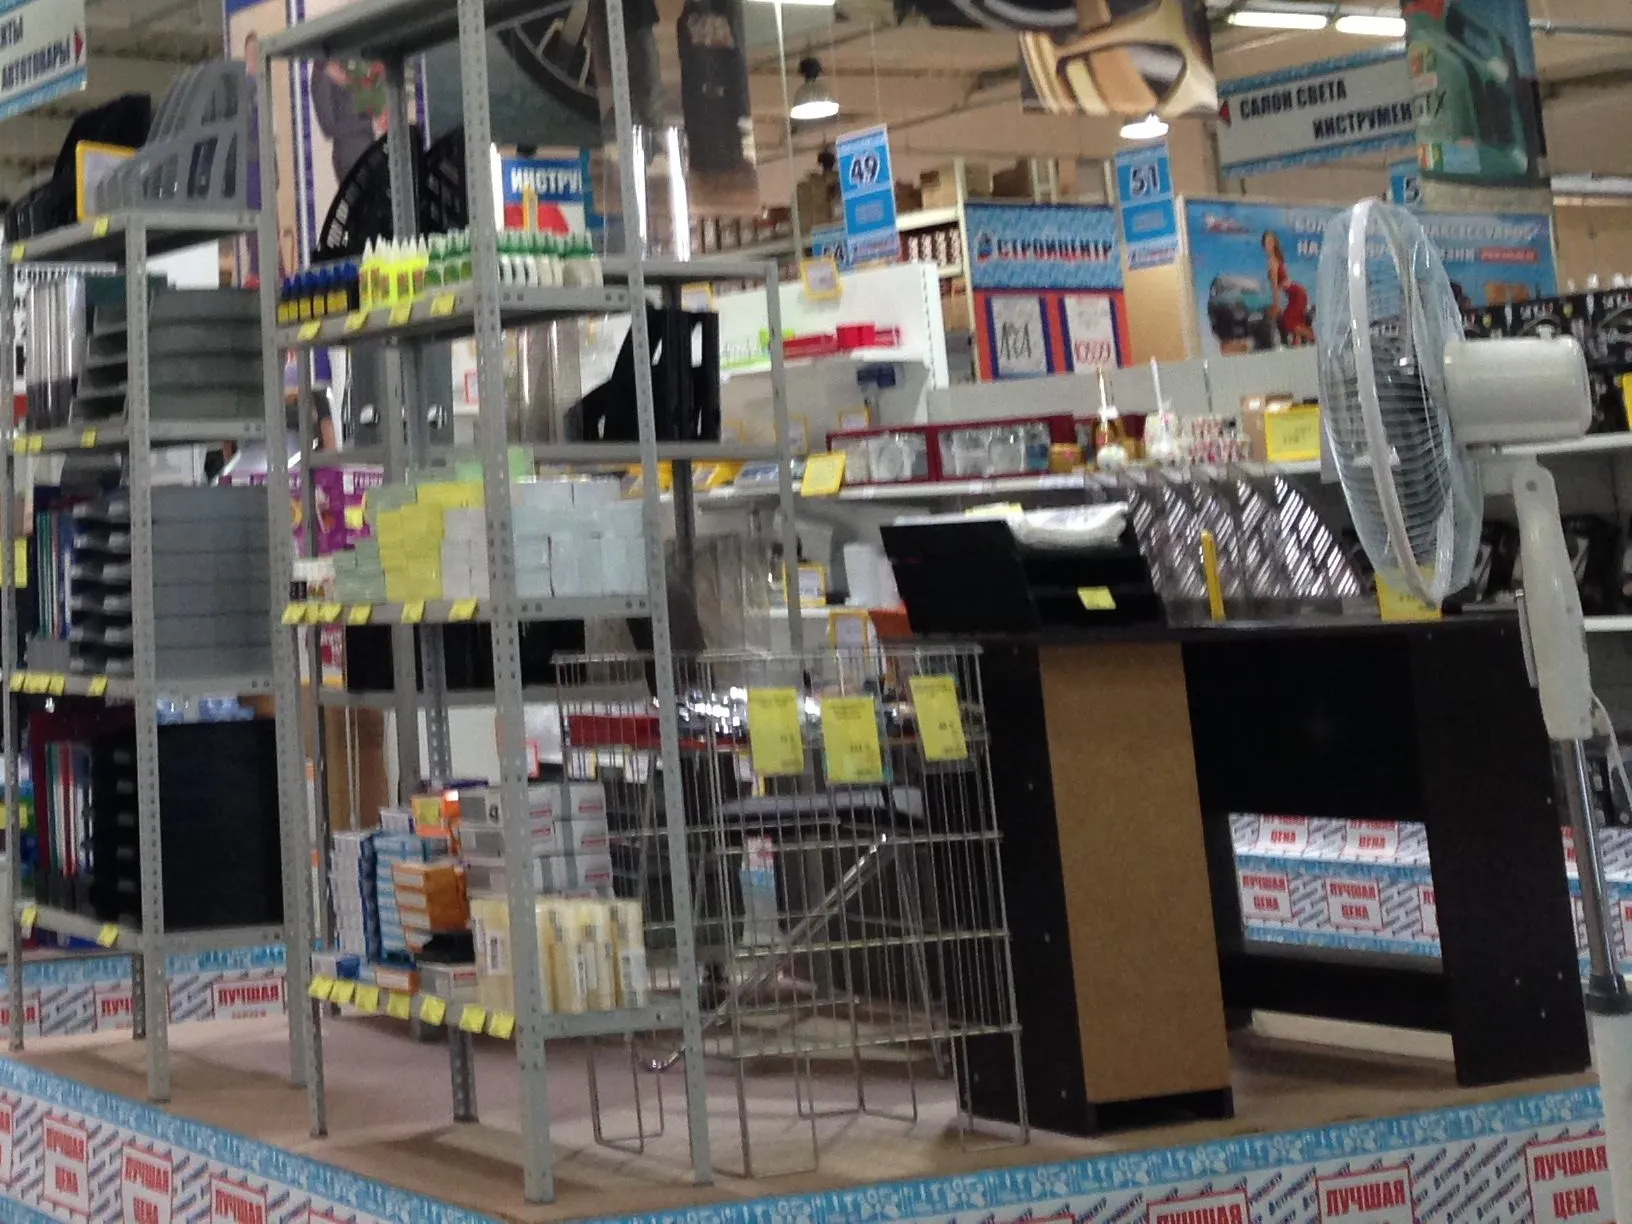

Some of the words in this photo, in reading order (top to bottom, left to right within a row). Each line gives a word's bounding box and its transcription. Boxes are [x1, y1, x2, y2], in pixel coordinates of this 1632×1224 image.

[1, 33, 71, 93] АВТОТОВАРЫ
[1239, 95, 1293, 120] САЛОН
[1297, 78, 1348, 111] СВЕТА
[1312, 100, 1413, 140] ИНСТРУМЕН
[510, 167, 582, 194] ИНСТРУ
[848, 154, 881, 185] 49
[1131, 164, 1160, 195] 51
[1242, 875, 1286, 893] ЛУЧШАЯ
[1329, 883, 1377, 900] ЛУЧШАЯ
[1253, 895, 1280, 911] ЦЕНА
[1341, 904, 1370, 921] ЦЕНА
[219, 984, 279, 1007] ЛУЧШАЯ
[125, 1156, 169, 1195] ЛУЧШАЯ
[1533, 1145, 1609, 1182] ЛУЧШАЯ
[1326, 1179, 1406, 1217] ЛУЧШАЯ
[1553, 1186, 1600, 1221] ЦЕНА
